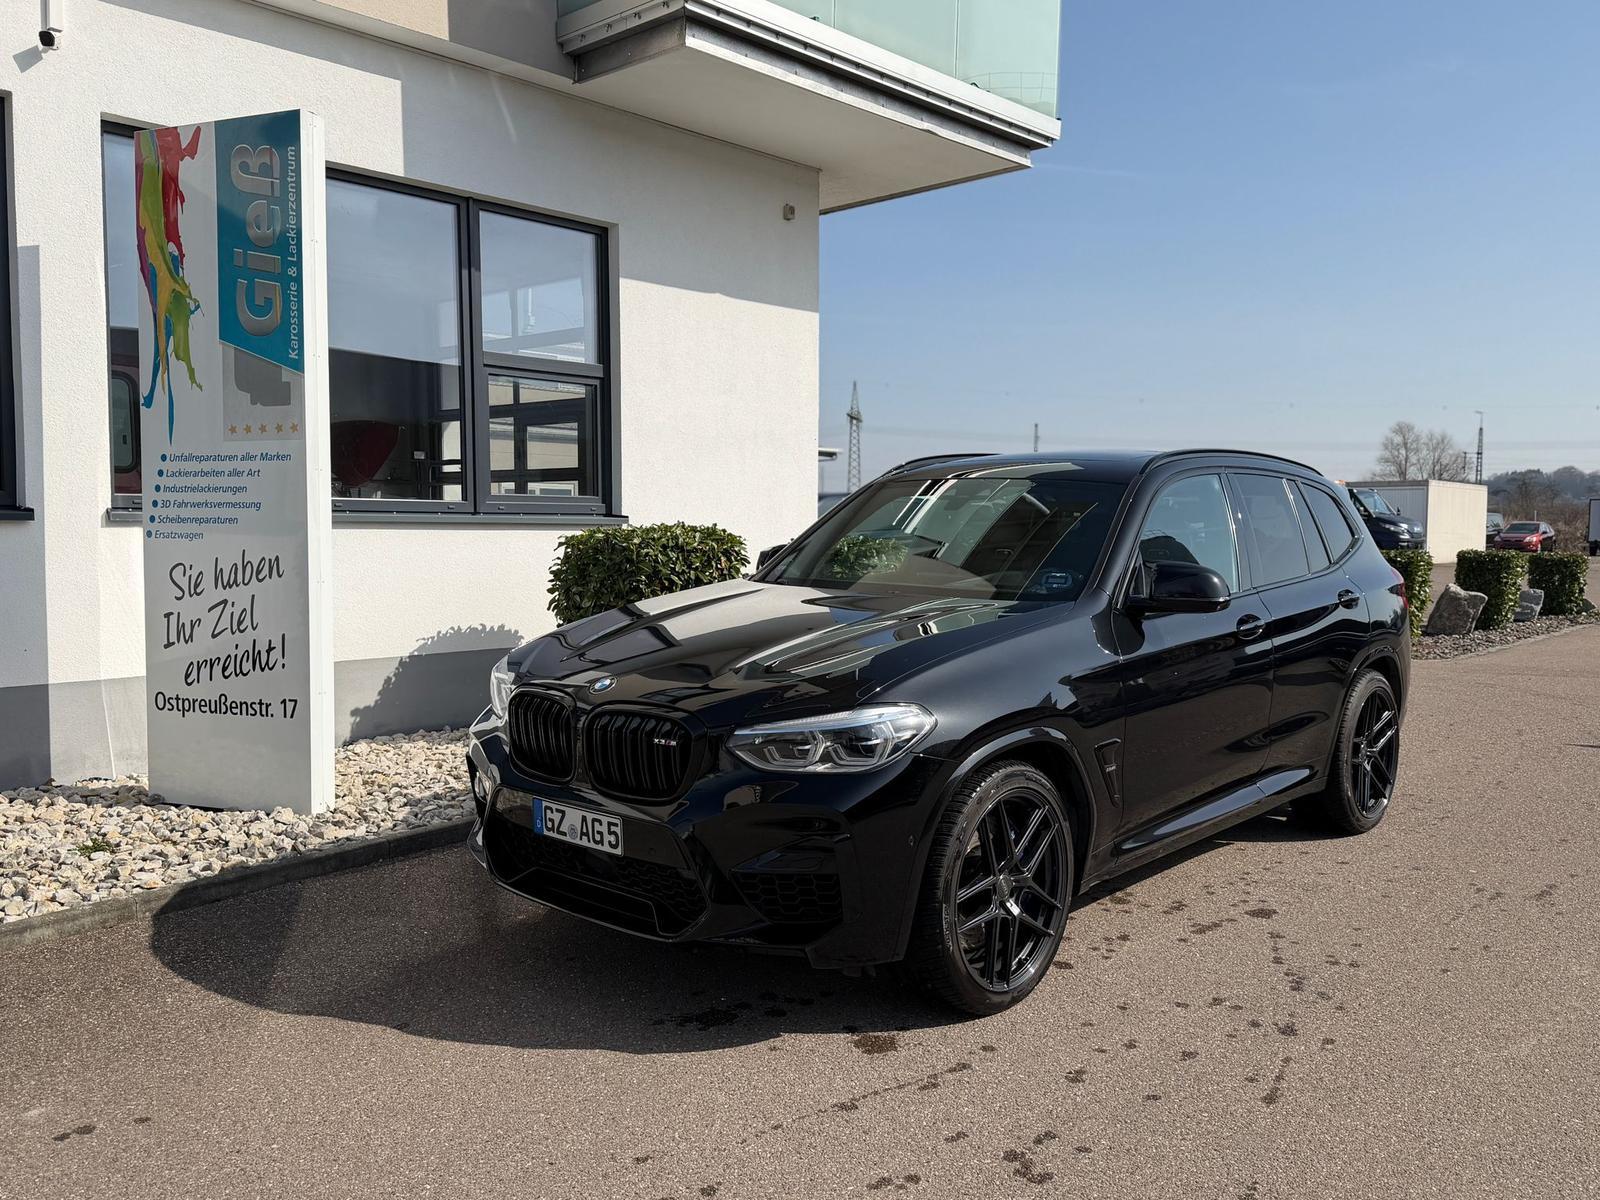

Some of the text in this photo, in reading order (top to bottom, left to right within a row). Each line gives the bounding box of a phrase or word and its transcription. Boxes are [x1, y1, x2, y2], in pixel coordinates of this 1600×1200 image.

[231, 144, 282, 337] Gieß
[287, 145, 298, 359] Karosserie & Lackierzentrum
[169, 452, 291, 464] Unfallreparaturen aller Marken
[166, 468, 261, 479] Lackierarbeiten aller Art
[163, 484, 248, 495] Industrielackierungen
[160, 499, 262, 512] 3D Fahrwerksvermessung
[157, 515, 239, 526] Scheibenreparaturen
[154, 530, 204, 541] Ersatzwagen
[169, 549, 285, 601] Sie haben
[163, 594, 259, 650] Ihr Ziel
[184, 633, 287, 687] erreicht!
[154, 691, 298, 719] Ostpreußenstr. 17
[543, 805, 567, 837] GZ
